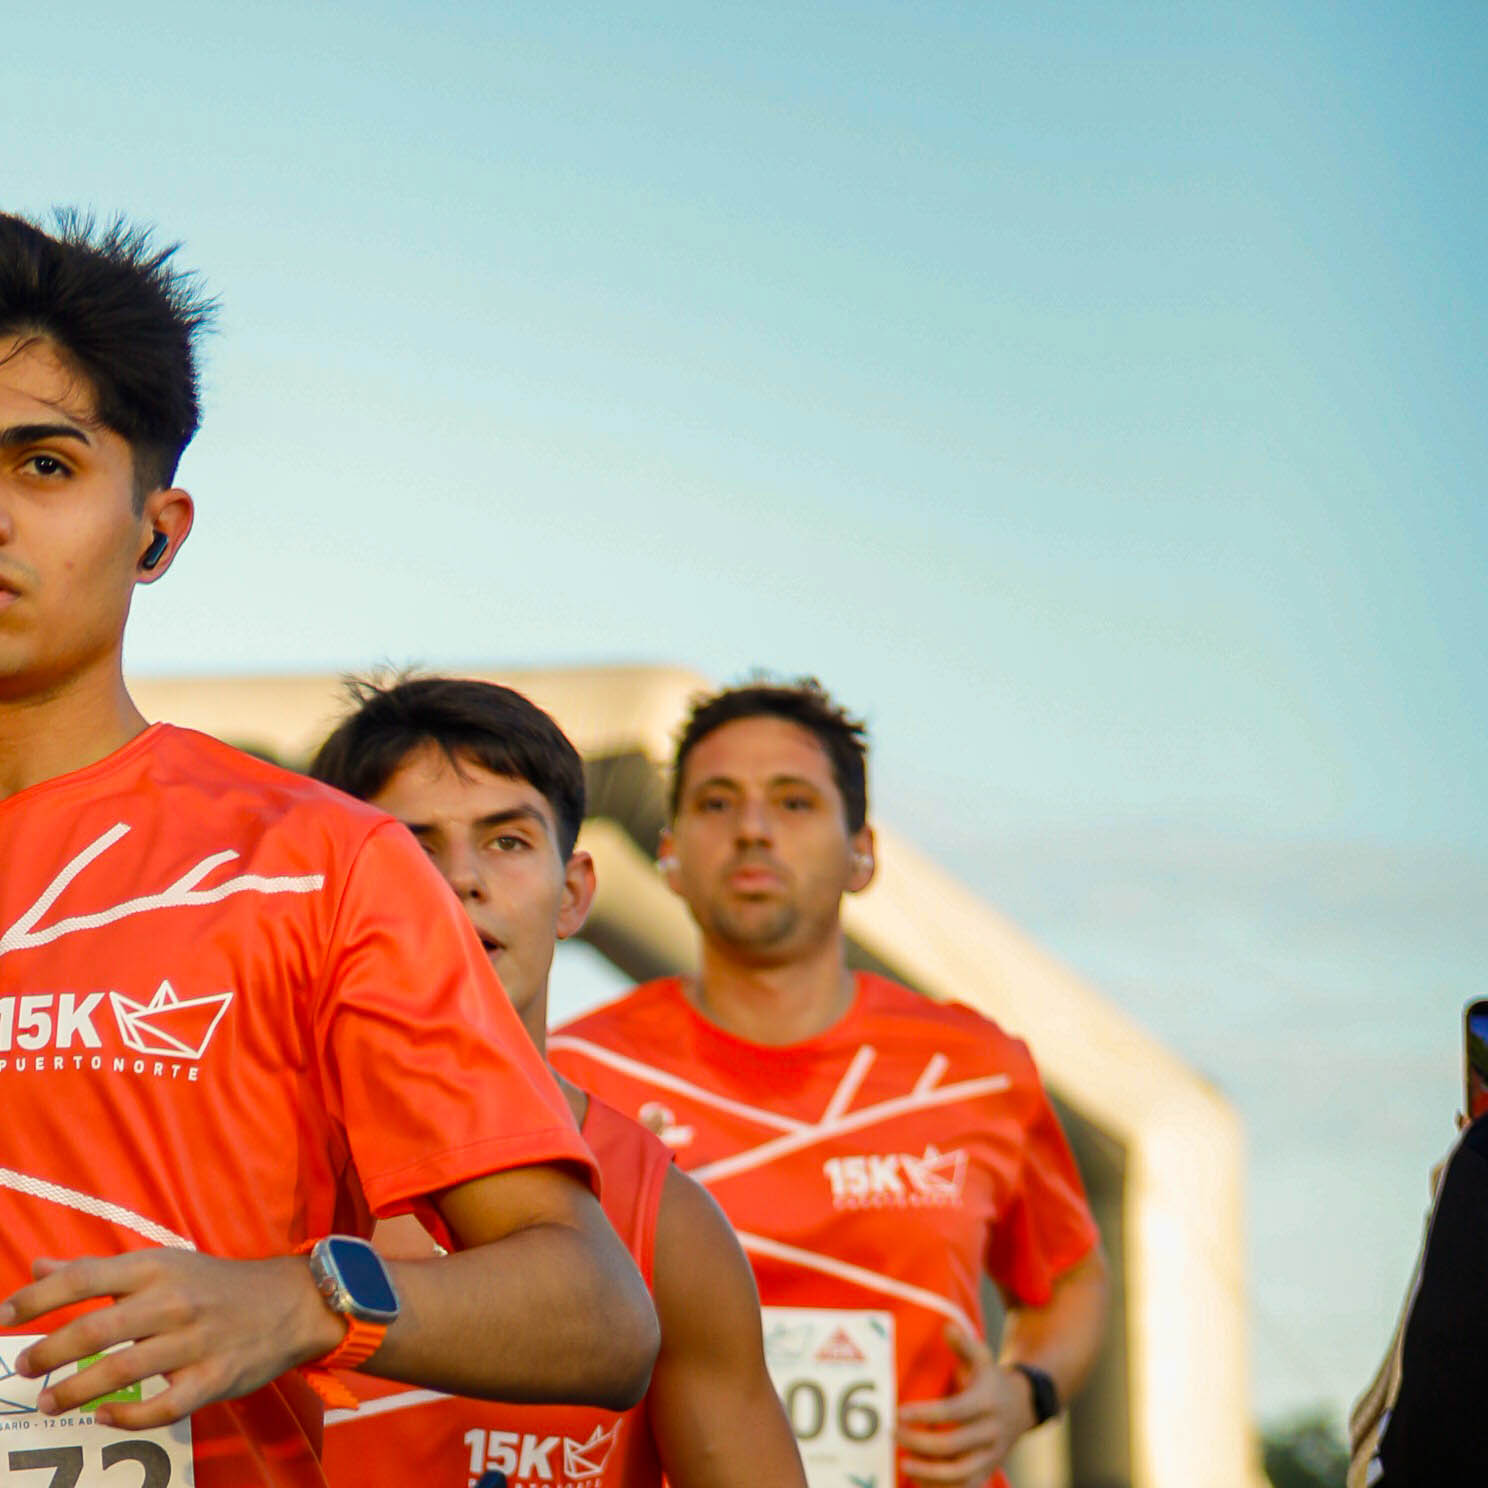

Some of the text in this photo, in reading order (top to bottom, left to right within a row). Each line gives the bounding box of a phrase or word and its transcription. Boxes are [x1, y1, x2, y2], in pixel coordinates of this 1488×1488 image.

[113, 1058, 199, 1081] NORTE
[44, 1419, 55, 1427] 12
[62, 1418, 74, 1426] DE
[786, 1379, 881, 1442] 06
[464, 1428, 560, 1479] 15K
